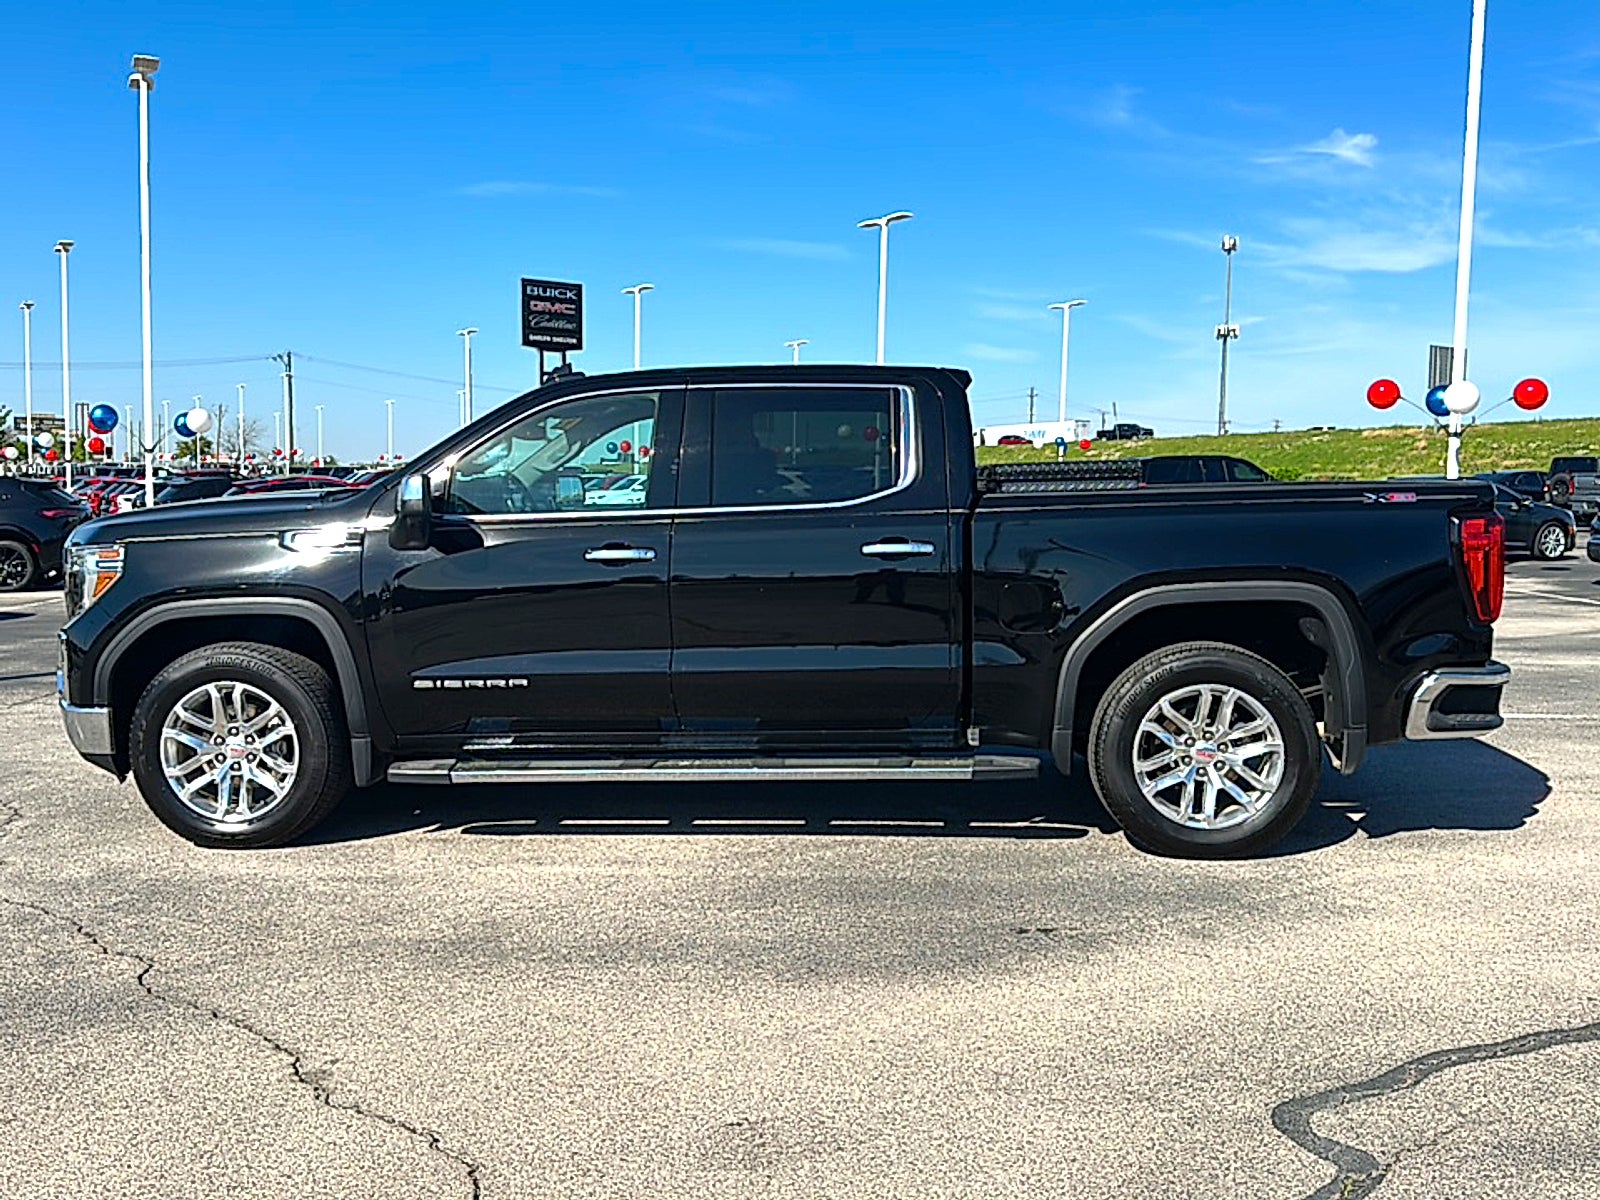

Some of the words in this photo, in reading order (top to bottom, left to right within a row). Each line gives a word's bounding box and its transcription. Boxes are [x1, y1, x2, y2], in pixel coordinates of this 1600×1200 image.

[526, 285, 578, 299] BUICK
[530, 300, 576, 315] GMC
[413, 678, 528, 688] SIERRA
